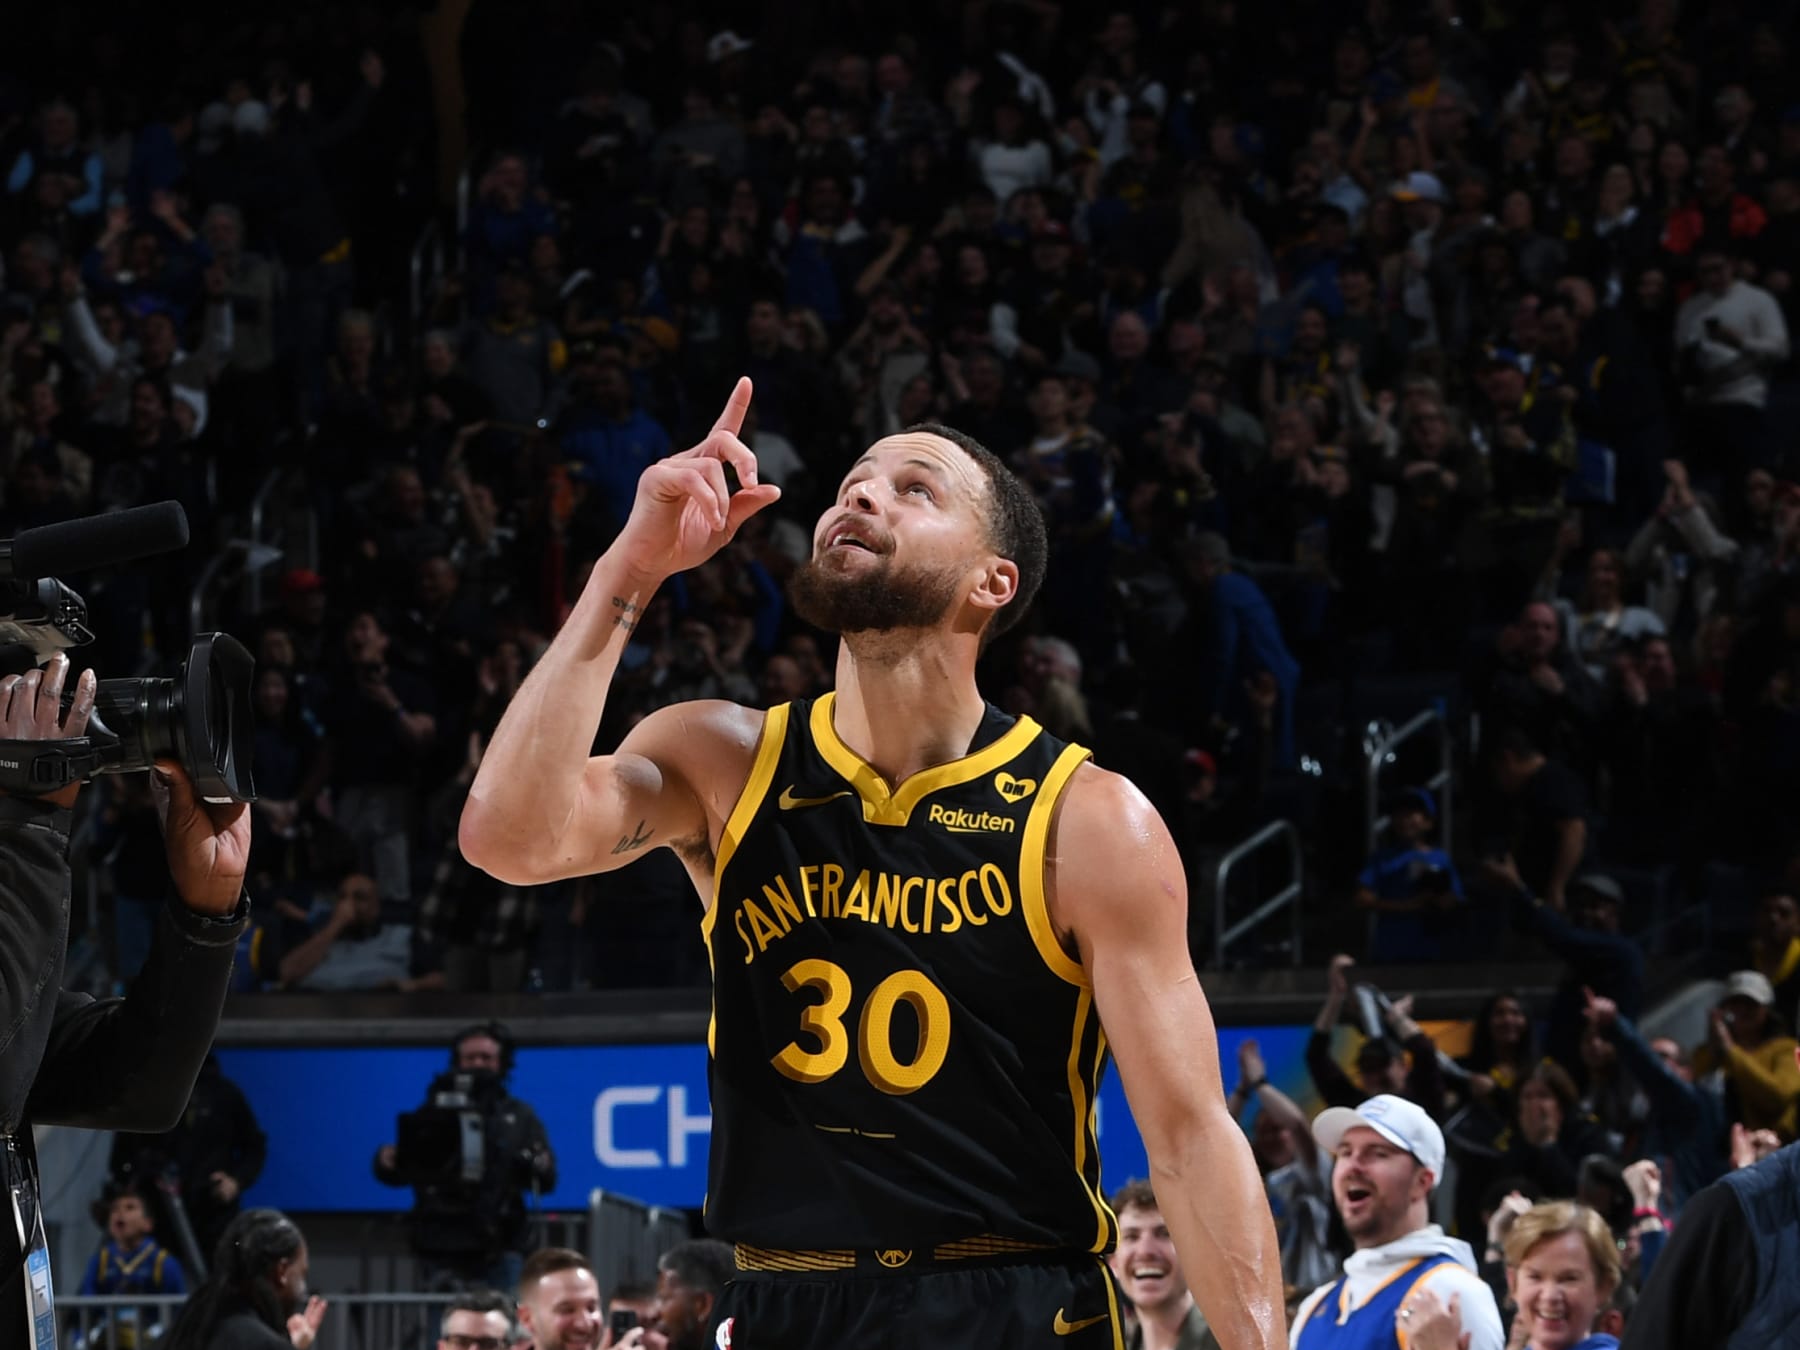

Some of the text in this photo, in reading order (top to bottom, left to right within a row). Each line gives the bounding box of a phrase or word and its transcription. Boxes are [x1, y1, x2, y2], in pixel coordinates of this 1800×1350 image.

[929, 804, 1015, 833] Rakuten
[734, 862, 1013, 965] SAN FRANCISCO
[769, 958, 951, 1096] 30
